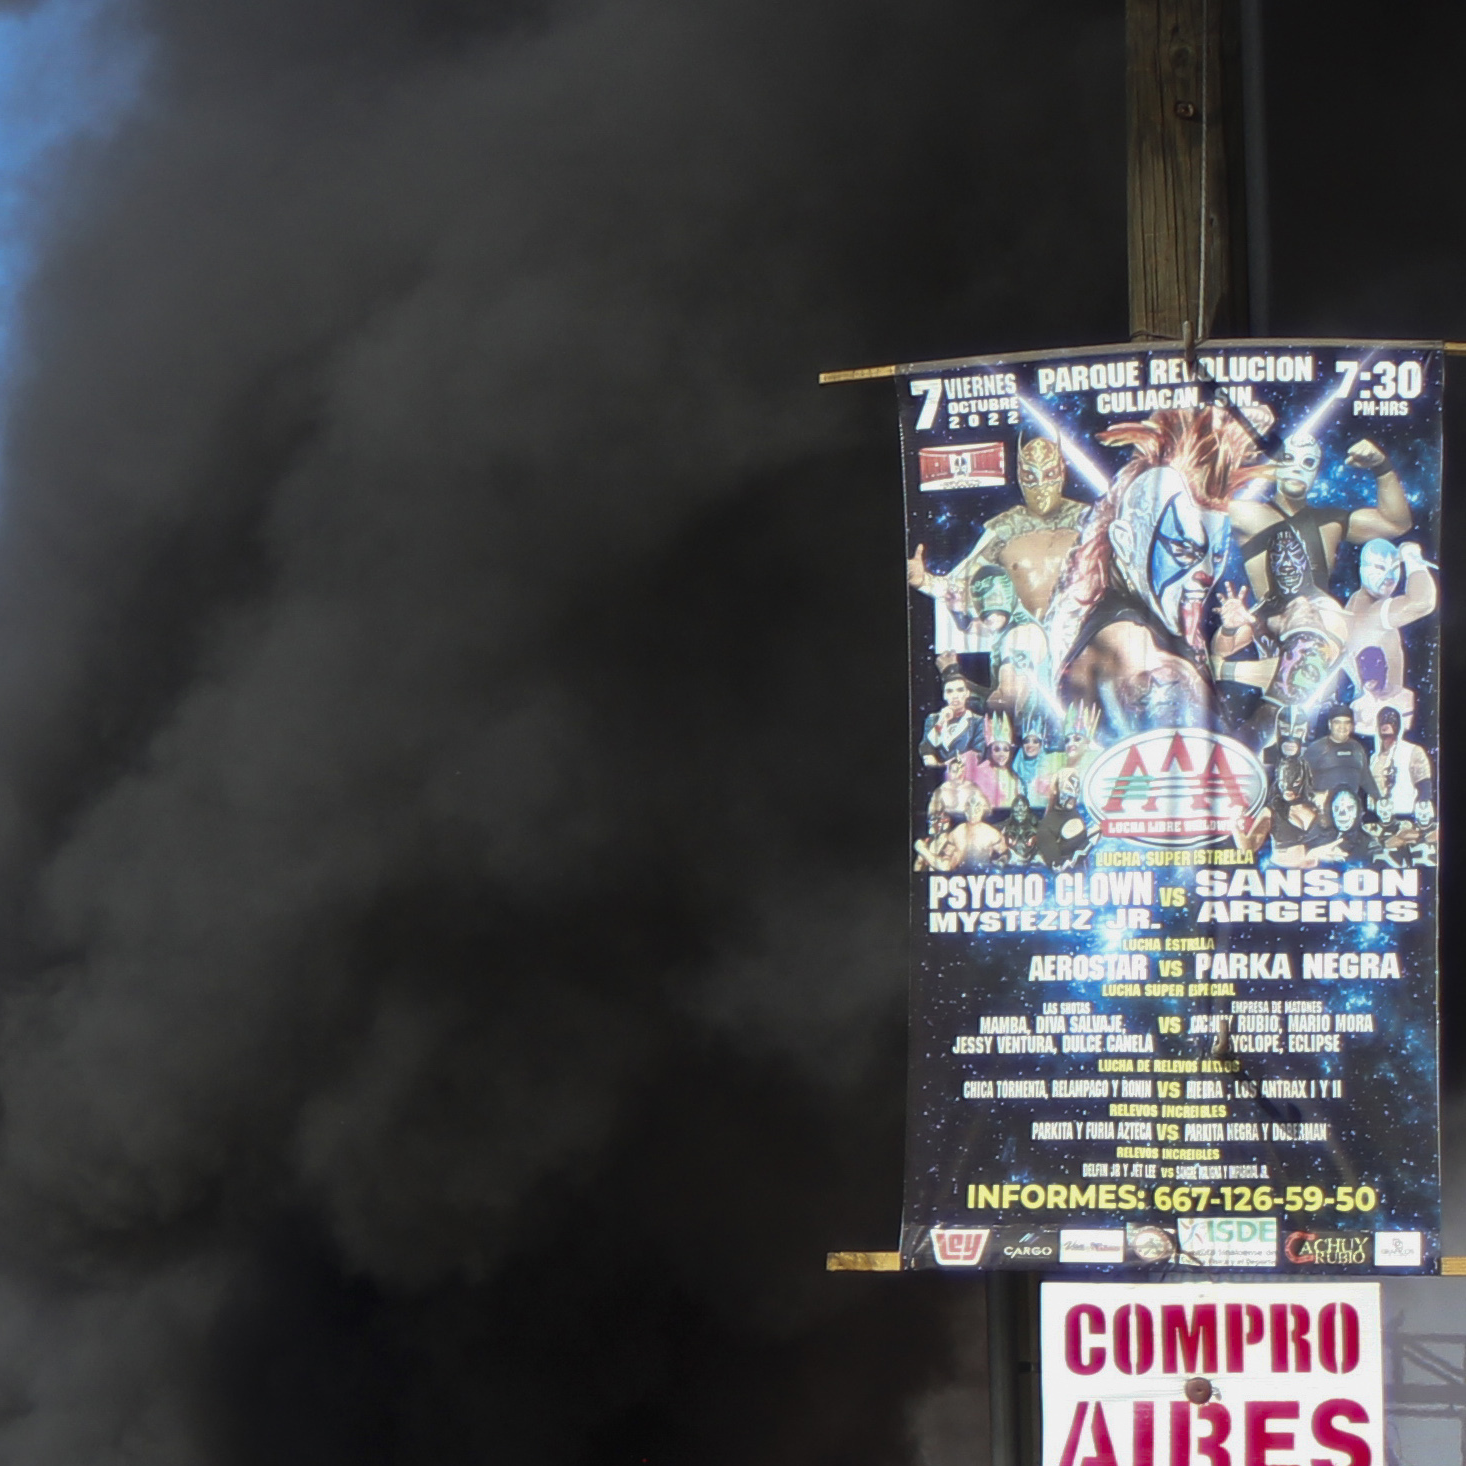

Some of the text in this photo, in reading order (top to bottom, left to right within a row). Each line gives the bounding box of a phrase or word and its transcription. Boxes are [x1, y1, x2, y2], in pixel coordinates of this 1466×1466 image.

[1038, 355, 1313, 394] PARQUE REVOLUCION
[1335, 360, 1422, 399] 7:30
[944, 374, 1016, 399] VIERNES
[911, 379, 942, 430] 7
[948, 397, 1019, 415] OCTUBRE
[1096, 386, 1259, 415] CULIACAN, SIN.
[1353, 400, 1408, 416] PM-HRS
[1102, 731, 1250, 811] AAA
[1096, 852, 1140, 867] LUCHA
[1146, 851, 1190, 866] SUPER
[929, 868, 1418, 909] PSYCHO CLOWN VS SANSON
[929, 908, 1162, 933] MYSTEZIZ JR.
[1197, 901, 1418, 922] ARGENIS
[1122, 938, 1161, 951] LUCHA
[1028, 953, 1401, 982] AEROSTAR VS PARKA NEGRA
[1102, 984, 1141, 997] LUCHA
[1144, 984, 1184, 997] SUPER
[1043, 1002, 1058, 1015] LAS
[1231, 1001, 1269, 1014] EMPRESA
[980, 1016, 1031, 1035] MAMBA,
[1035, 1015, 1066, 1034] DIVA
[1070, 1015, 1126, 1035] SALVAJE,
[1158, 1016, 1182, 1034] VS
[1238, 1014, 1283, 1034] RUBIO,
[1288, 1014, 1331, 1033] MARIO
[1335, 1014, 1374, 1033] MORA
[952, 1034, 1154, 1055] JESSY VENTURA, DULCE CANELA
[1288, 1034, 1341, 1053] ECLIPSE
[1098, 1059, 1134, 1073] LUCHA
[1137, 1059, 1150, 1073] DE
[1153, 1060, 1198, 1074] RELEVOS
[963, 1080, 994, 1099] CHICA
[997, 1079, 1049, 1100] TORMENTA,
[1111, 1079, 1119, 1098] Y
[1122, 1079, 1152, 1098] RONIN
[1156, 1081, 1181, 1098] VS
[1235, 1080, 1258, 1098] LOS
[1261, 1080, 1307, 1098] ANTRAX
[1319, 1080, 1330, 1098] Y
[1109, 1104, 1158, 1117] RELEVOS
[1031, 1122, 1328, 1142] PARKITA Y FURIA AZTECA VS PARKITA NEGRA Y DOBERMAN
[1117, 1147, 1220, 1160] RELEVOS INCREIBLES
[967, 1184, 1376, 1212] INFORMES: 667-126-59-50
[1207, 1220, 1277, 1243] ISDE
[1004, 1246, 1052, 1258] CARGO
[1064, 1302, 1360, 1375] COMPRO
